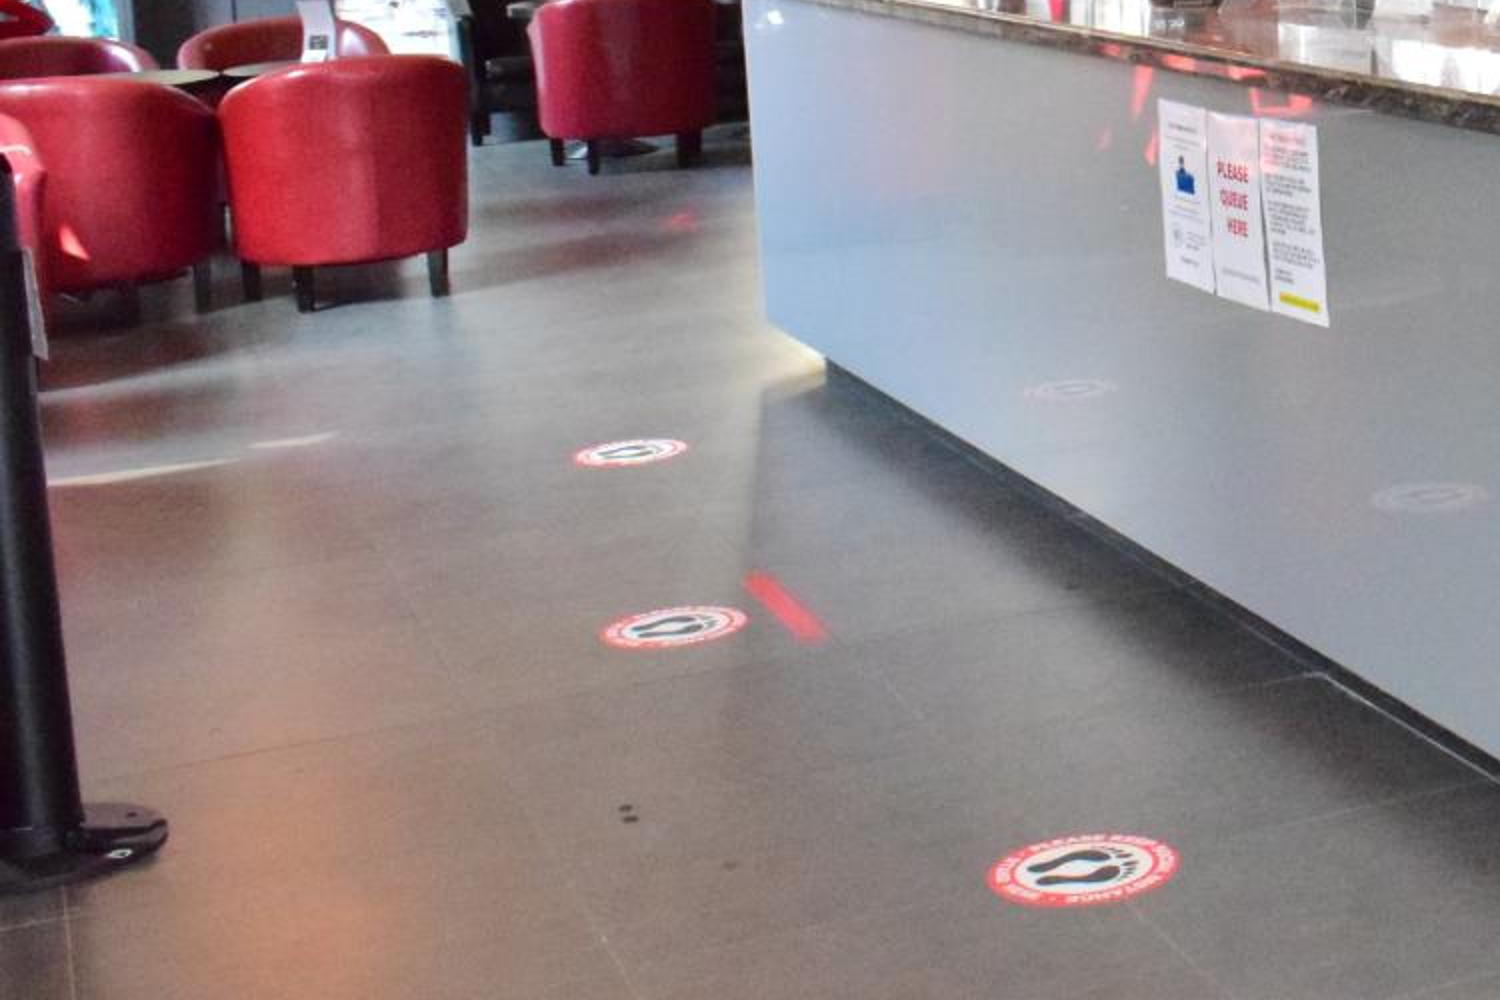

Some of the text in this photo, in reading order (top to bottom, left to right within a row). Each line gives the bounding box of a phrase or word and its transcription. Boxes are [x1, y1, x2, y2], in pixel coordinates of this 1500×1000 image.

[1216, 159, 1249, 184] PLEASE
[1220, 188, 1249, 212] QUEUE
[1226, 217, 1249, 238] HERE
